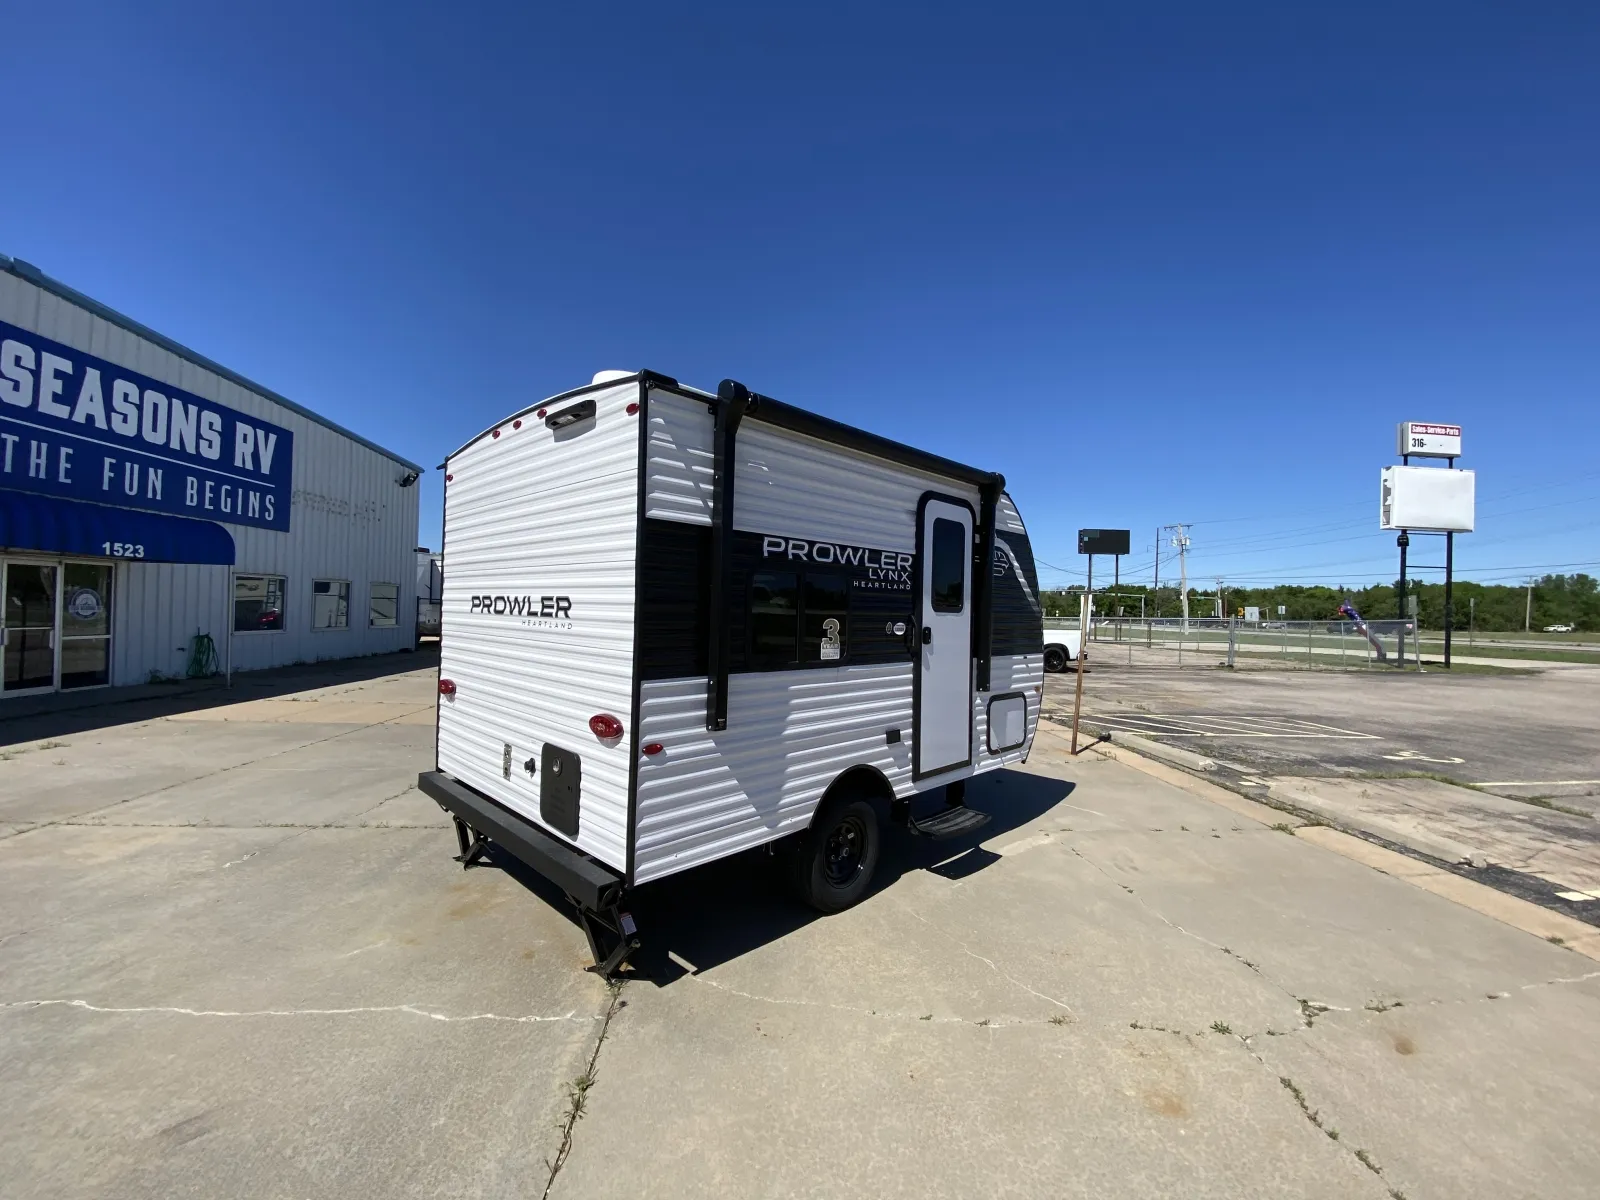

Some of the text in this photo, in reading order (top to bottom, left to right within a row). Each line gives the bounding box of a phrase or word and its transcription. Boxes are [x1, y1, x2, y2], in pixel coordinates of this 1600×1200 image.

[0, 339, 277, 475] SEASONS RV
[0, 433, 275, 521] THE FUN BEGINS
[102, 541, 145, 558] 1523
[763, 537, 912, 571] PROWLER
[853, 580, 911, 591] HEARTLAND
[869, 568, 911, 585] LYNX
[470, 595, 572, 619] PROWLER
[521, 619, 573, 630] HEARTLAND
[822, 618, 840, 644] 3
